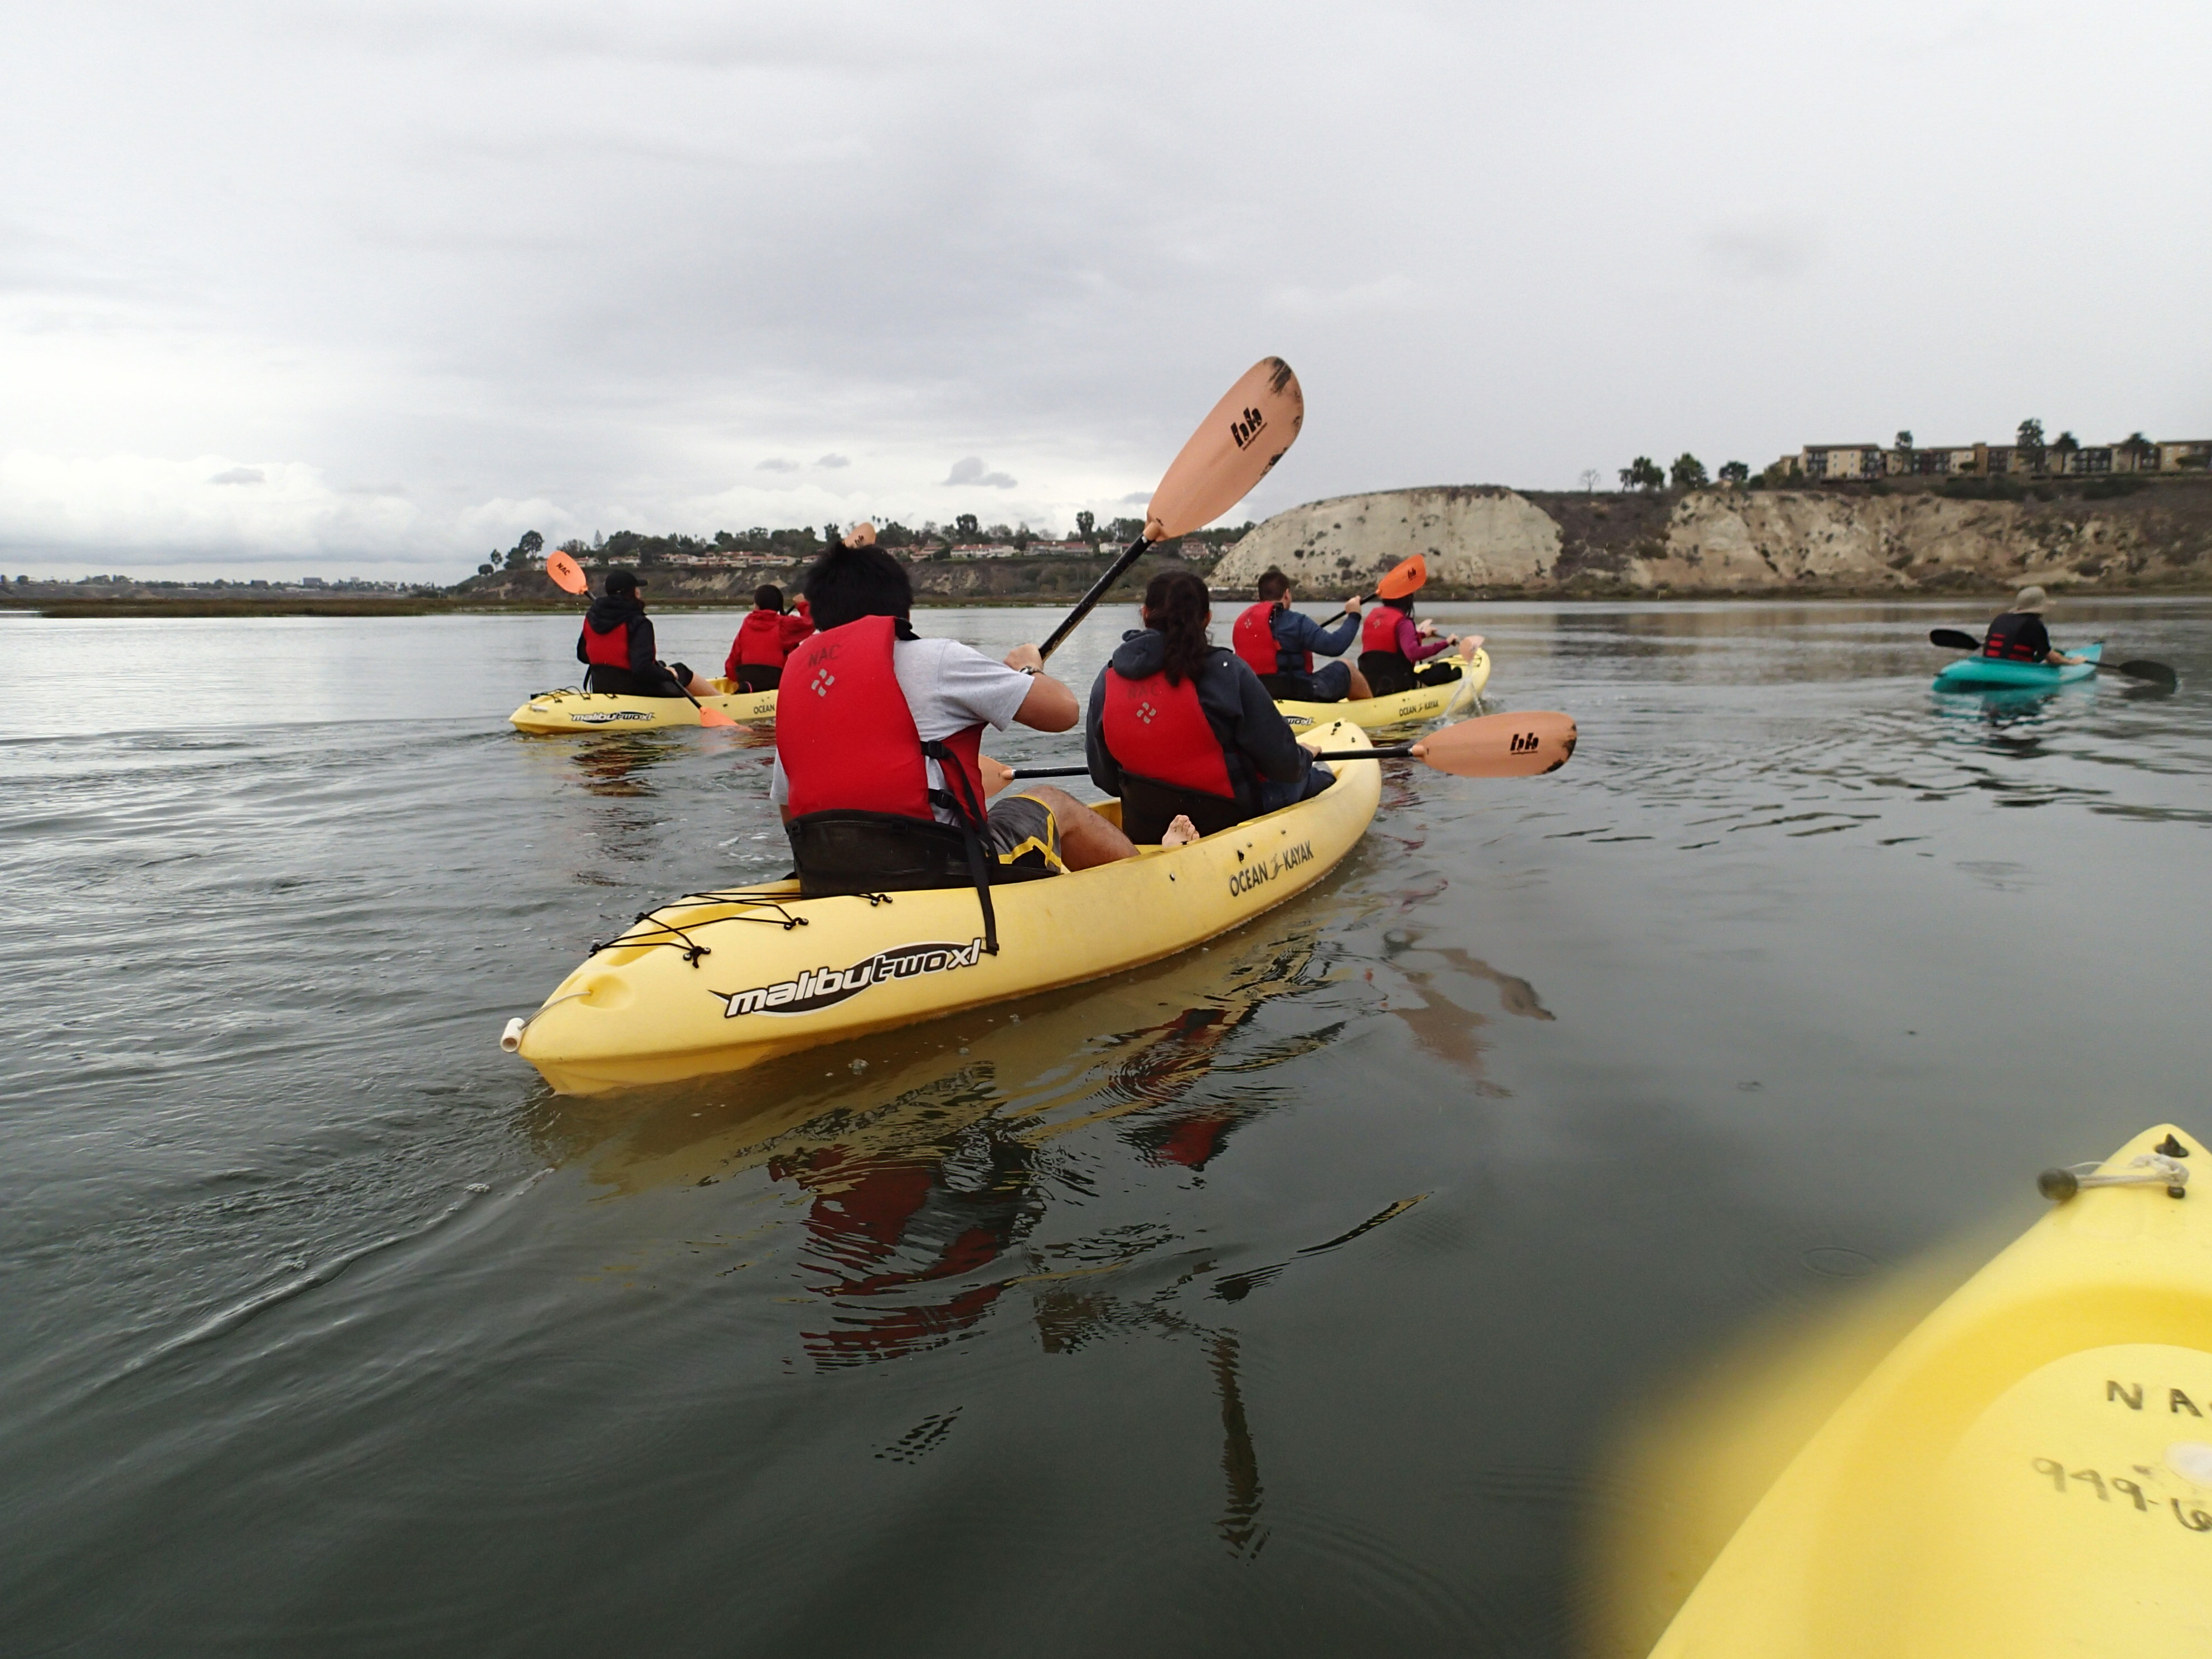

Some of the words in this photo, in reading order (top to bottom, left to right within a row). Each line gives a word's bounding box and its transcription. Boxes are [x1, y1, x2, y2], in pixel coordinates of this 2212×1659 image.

[556, 562, 570, 576] NAC
[808, 644, 841, 668] NAC
[753, 704, 775, 714] OCEAN
[1229, 861, 1269, 897] OCEAN
[1283, 840, 1314, 871] KAYAK
